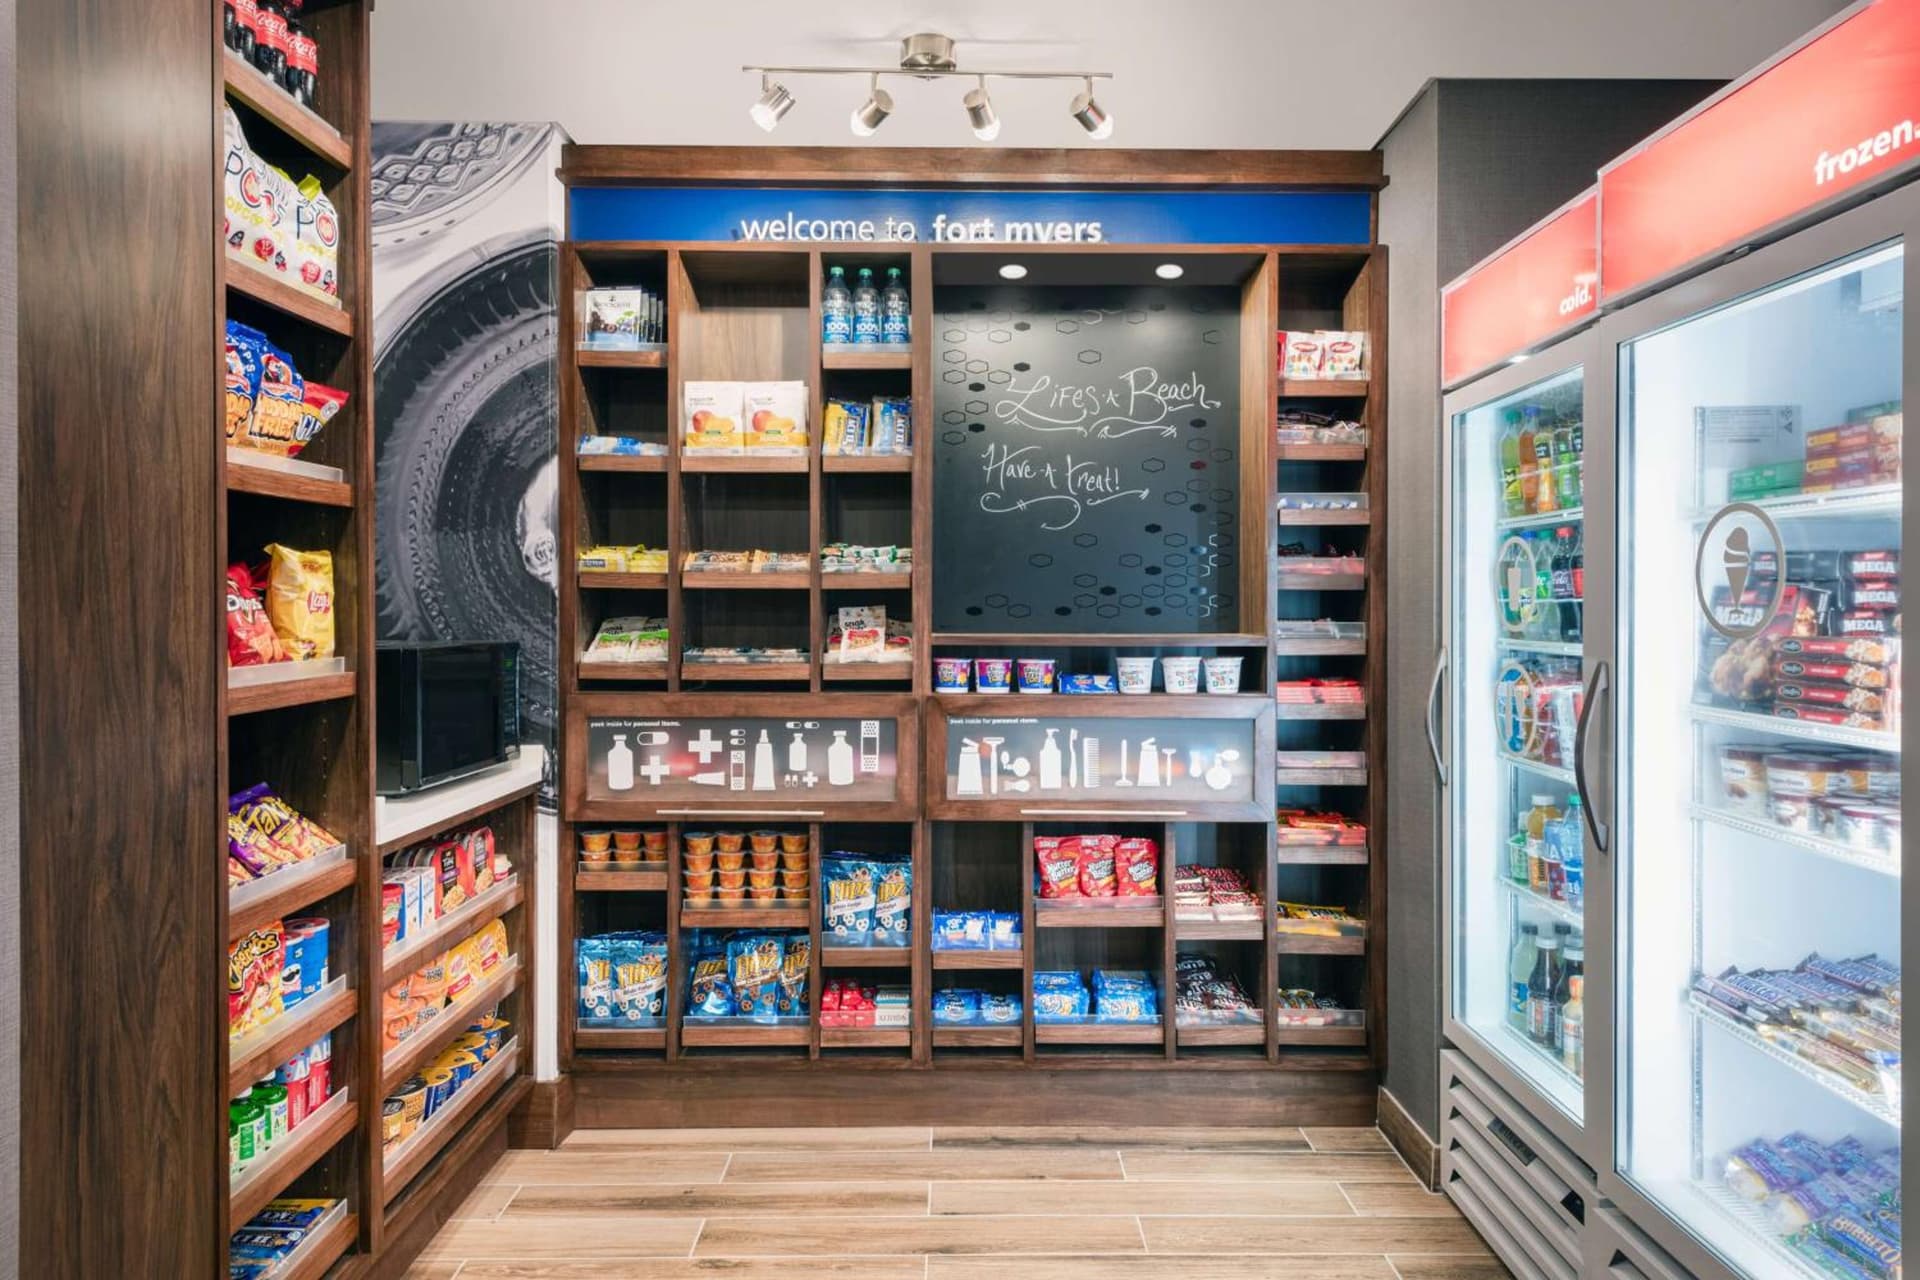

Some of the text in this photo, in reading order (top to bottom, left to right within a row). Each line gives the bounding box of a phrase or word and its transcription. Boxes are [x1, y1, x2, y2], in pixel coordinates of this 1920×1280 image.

[741, 211, 875, 241] welcome
[885, 216, 915, 241] to
[932, 214, 994, 243] fort
[981, 443, 1043, 491] Have
